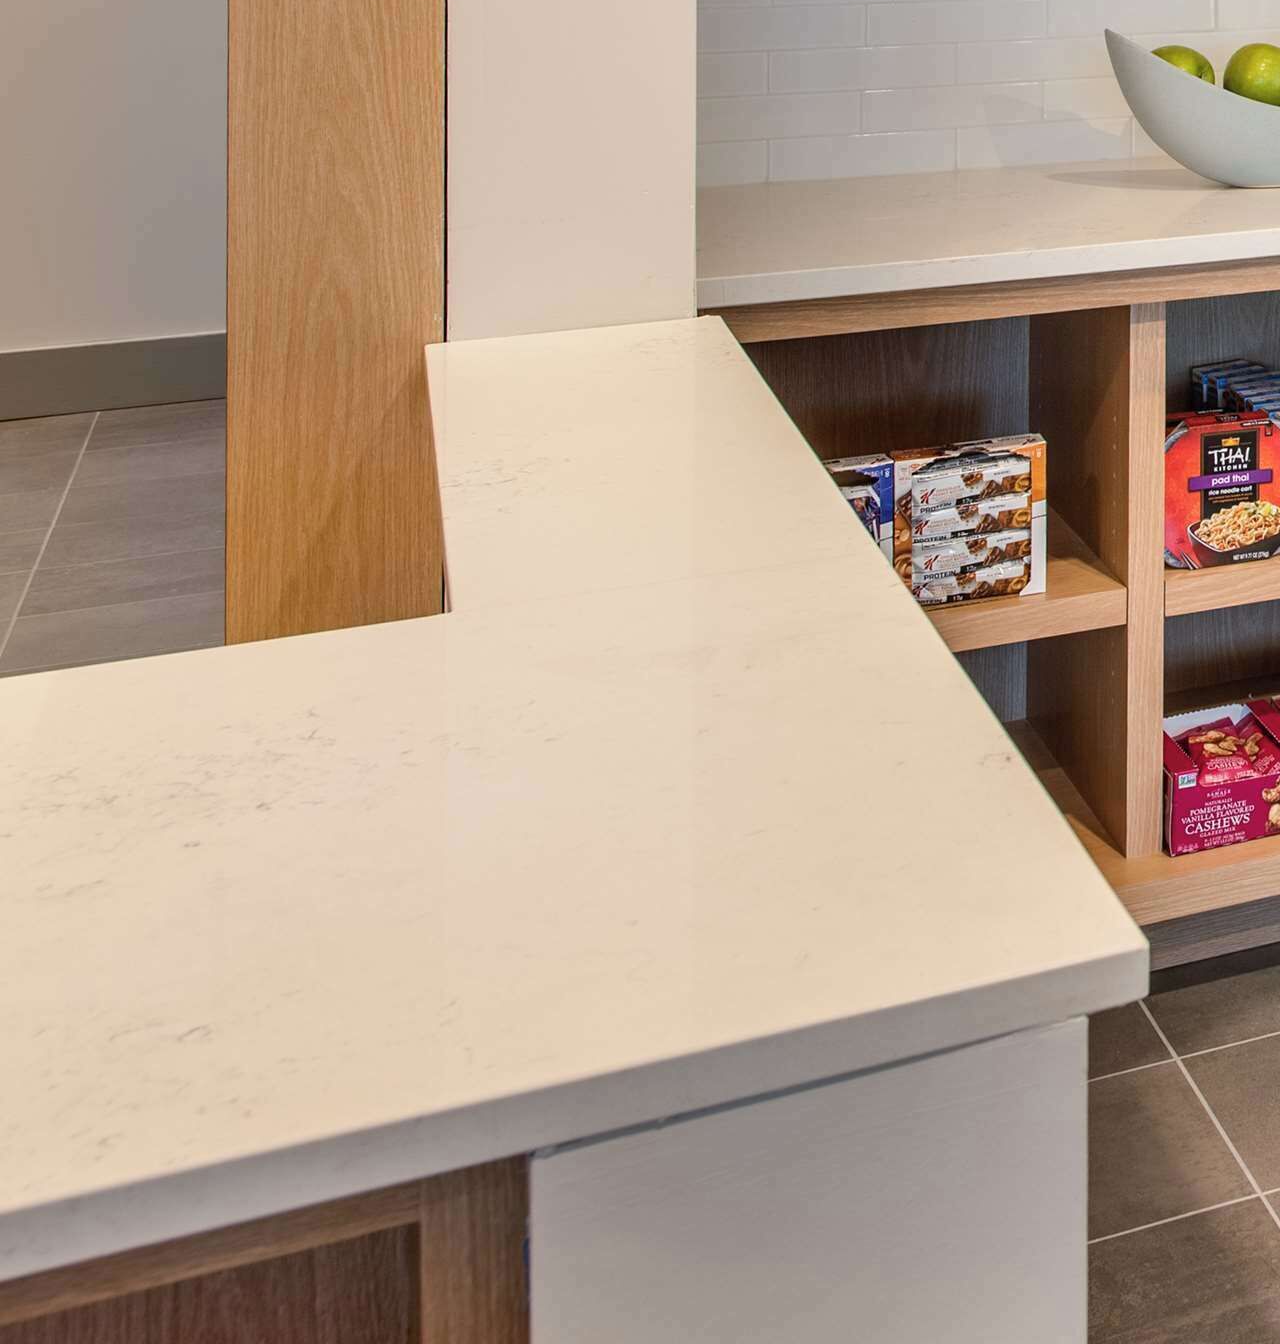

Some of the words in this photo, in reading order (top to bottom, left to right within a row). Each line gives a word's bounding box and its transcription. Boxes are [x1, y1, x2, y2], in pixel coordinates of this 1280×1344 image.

[1208, 447, 1250, 466] THAI
[1211, 475, 1230, 487] pad
[1232, 473, 1250, 483] thai
[1181, 812, 1214, 825] VANILLA
[1216, 805, 1255, 818] FLAVORED
[1190, 800, 1247, 816] POMEGRANATE
[1185, 813, 1251, 835] CASHEWS
